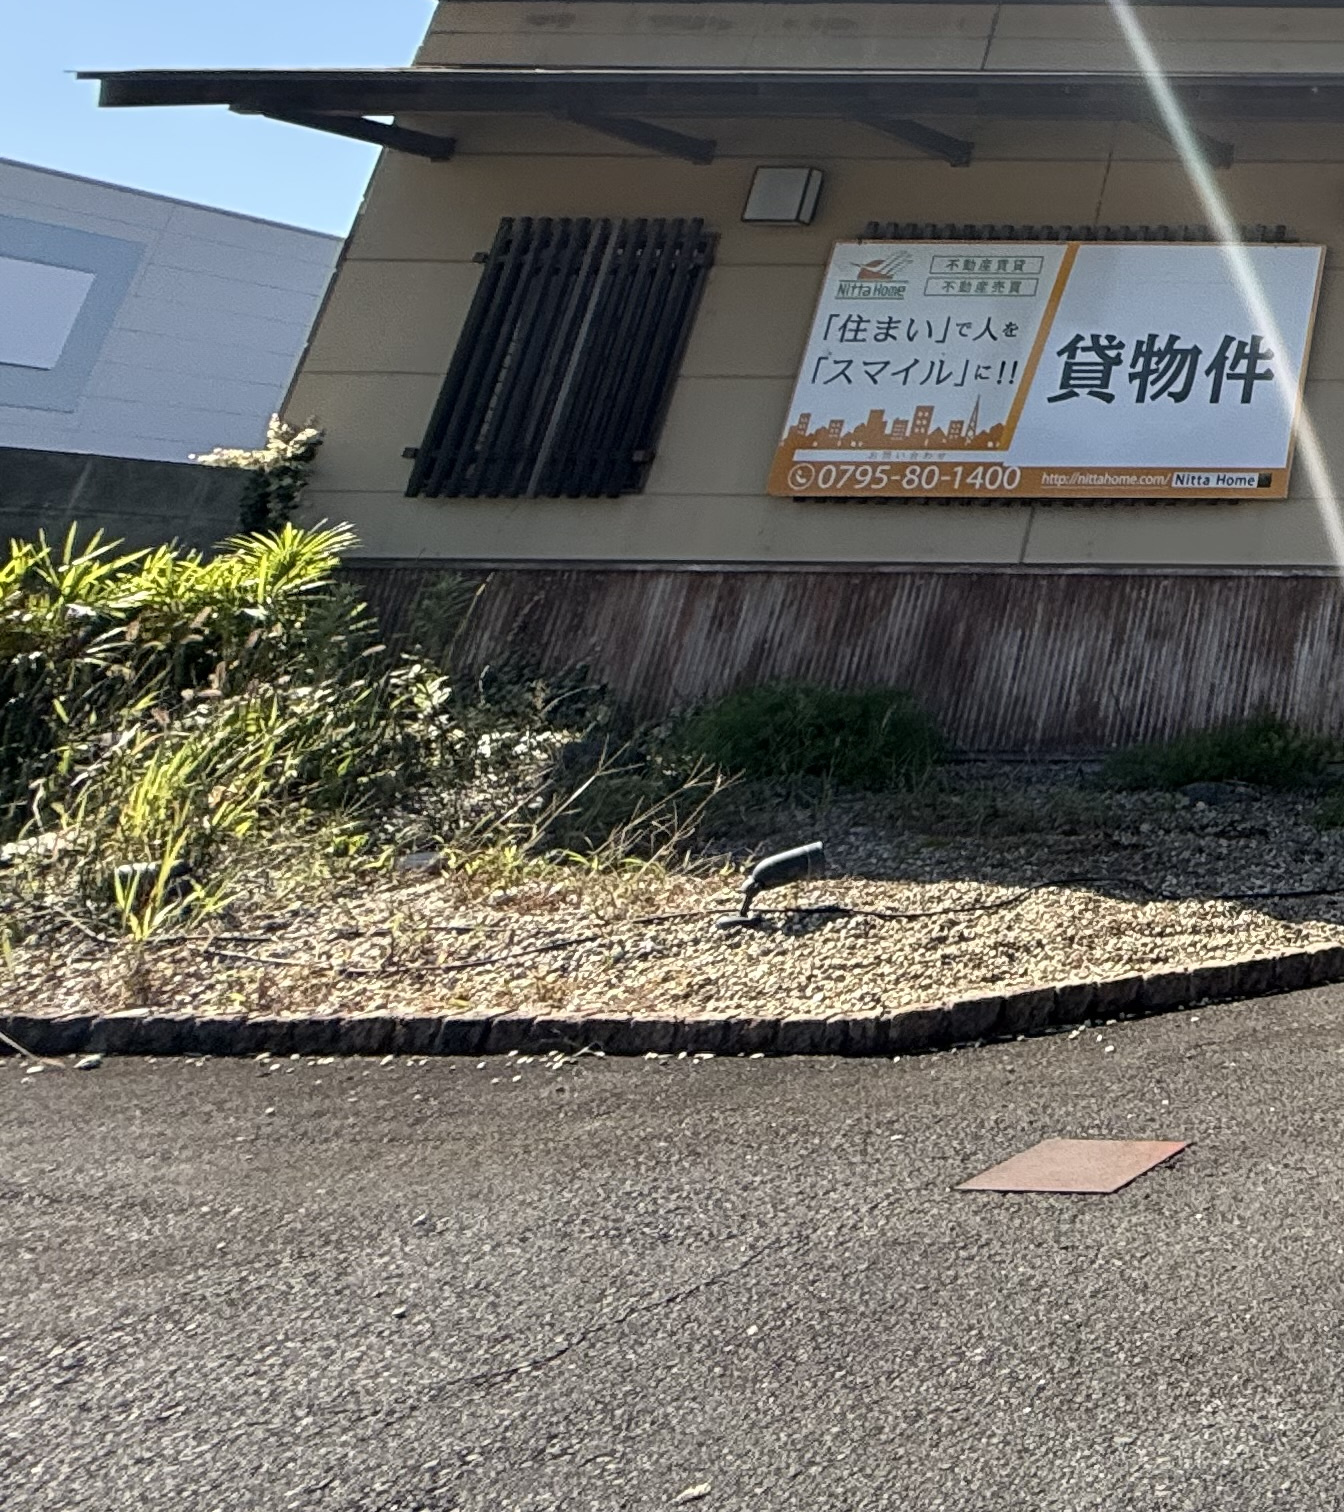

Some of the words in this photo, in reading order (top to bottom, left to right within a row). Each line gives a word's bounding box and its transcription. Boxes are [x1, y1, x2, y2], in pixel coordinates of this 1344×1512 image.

[836, 283, 871, 297] Nitta
[873, 284, 906, 298] Home
[941, 280, 1022, 294] 不動産売買
[823, 313, 1019, 344] 「住まい」で人を
[1046, 333, 1276, 405] 貸物件
[817, 464, 1022, 490] 0795-80-1400
[1041, 471, 1172, 486] http://nittahome.com/
[1174, 472, 1211, 486] Nitta
[1216, 473, 1256, 487] Home
